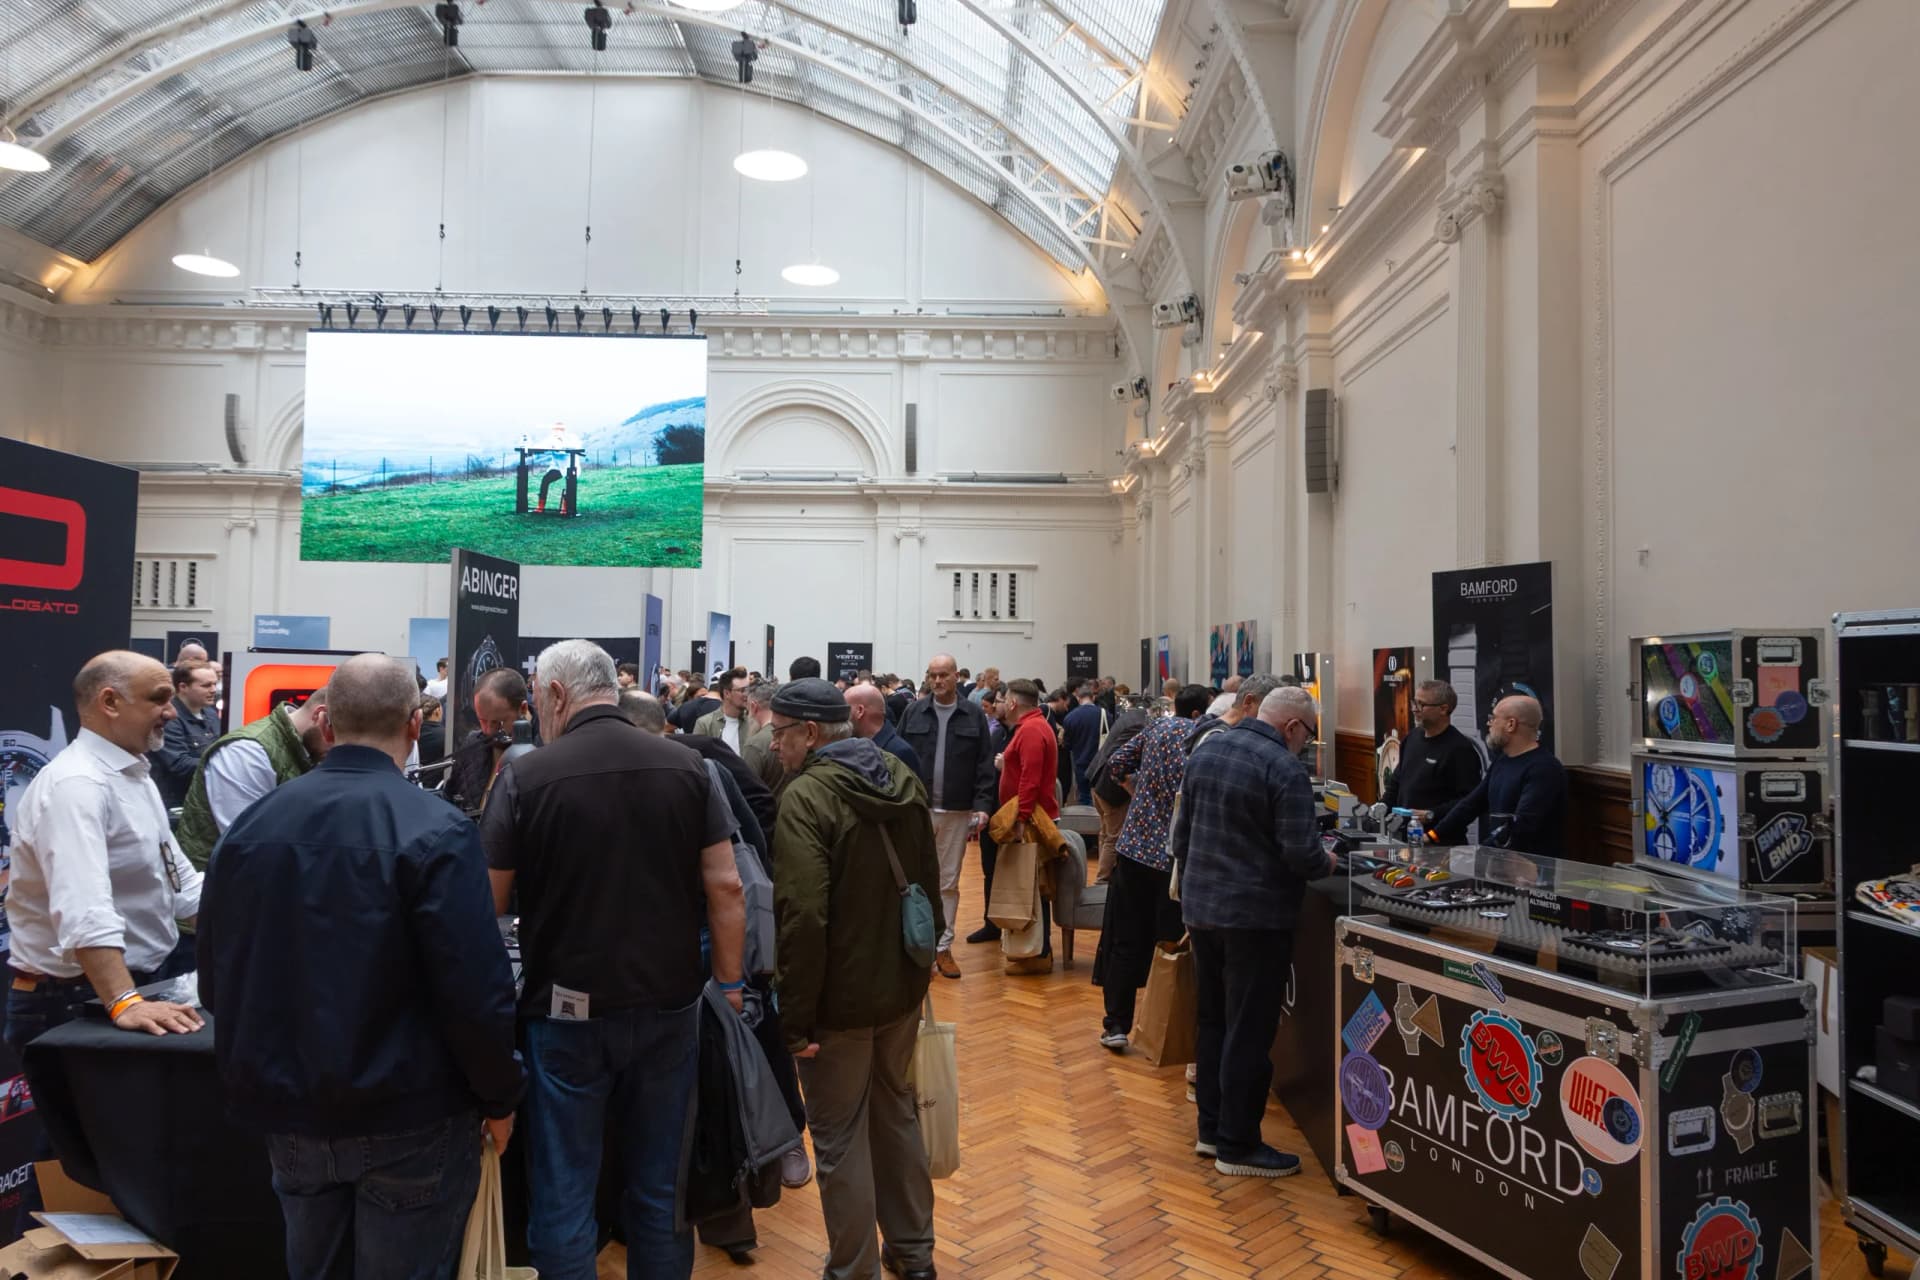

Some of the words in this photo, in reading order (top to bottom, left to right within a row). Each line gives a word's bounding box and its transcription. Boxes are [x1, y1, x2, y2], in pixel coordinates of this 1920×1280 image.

[461, 565, 518, 600] ABINGER
[1460, 578, 1518, 597] BAMFORD
[834, 653, 865, 661] VERTEX
[1757, 817, 1790, 853] BWD
[1768, 833, 1802, 870] BWD
[1470, 1020, 1533, 1107] BWD
[1410, 1137, 1536, 1210] LONDON
[1724, 1160, 1778, 1186] FRAGILE
[1684, 1229, 1757, 1280] BWD
